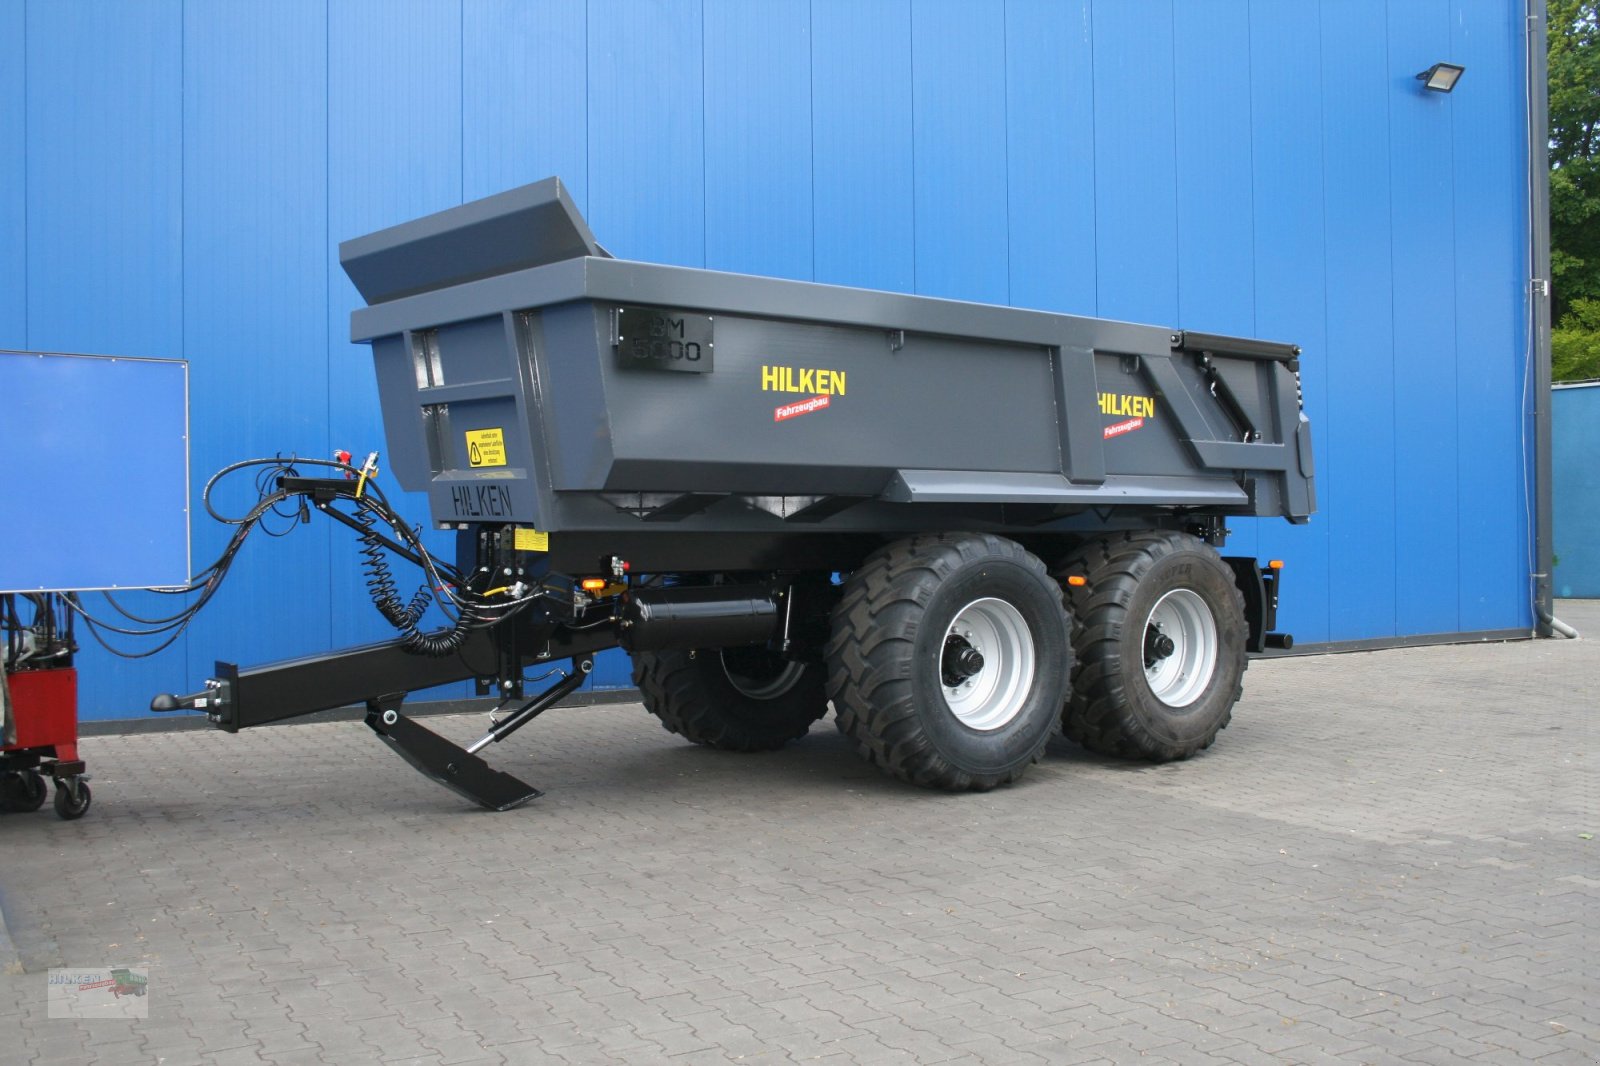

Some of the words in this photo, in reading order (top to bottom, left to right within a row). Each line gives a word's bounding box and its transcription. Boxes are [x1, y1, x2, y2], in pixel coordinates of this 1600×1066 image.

[761, 365, 846, 396] HILKEN
[776, 396, 828, 419] Fahrzeugbau
[1097, 392, 1154, 418] HILKEN
[451, 485, 513, 516] HILKEN
